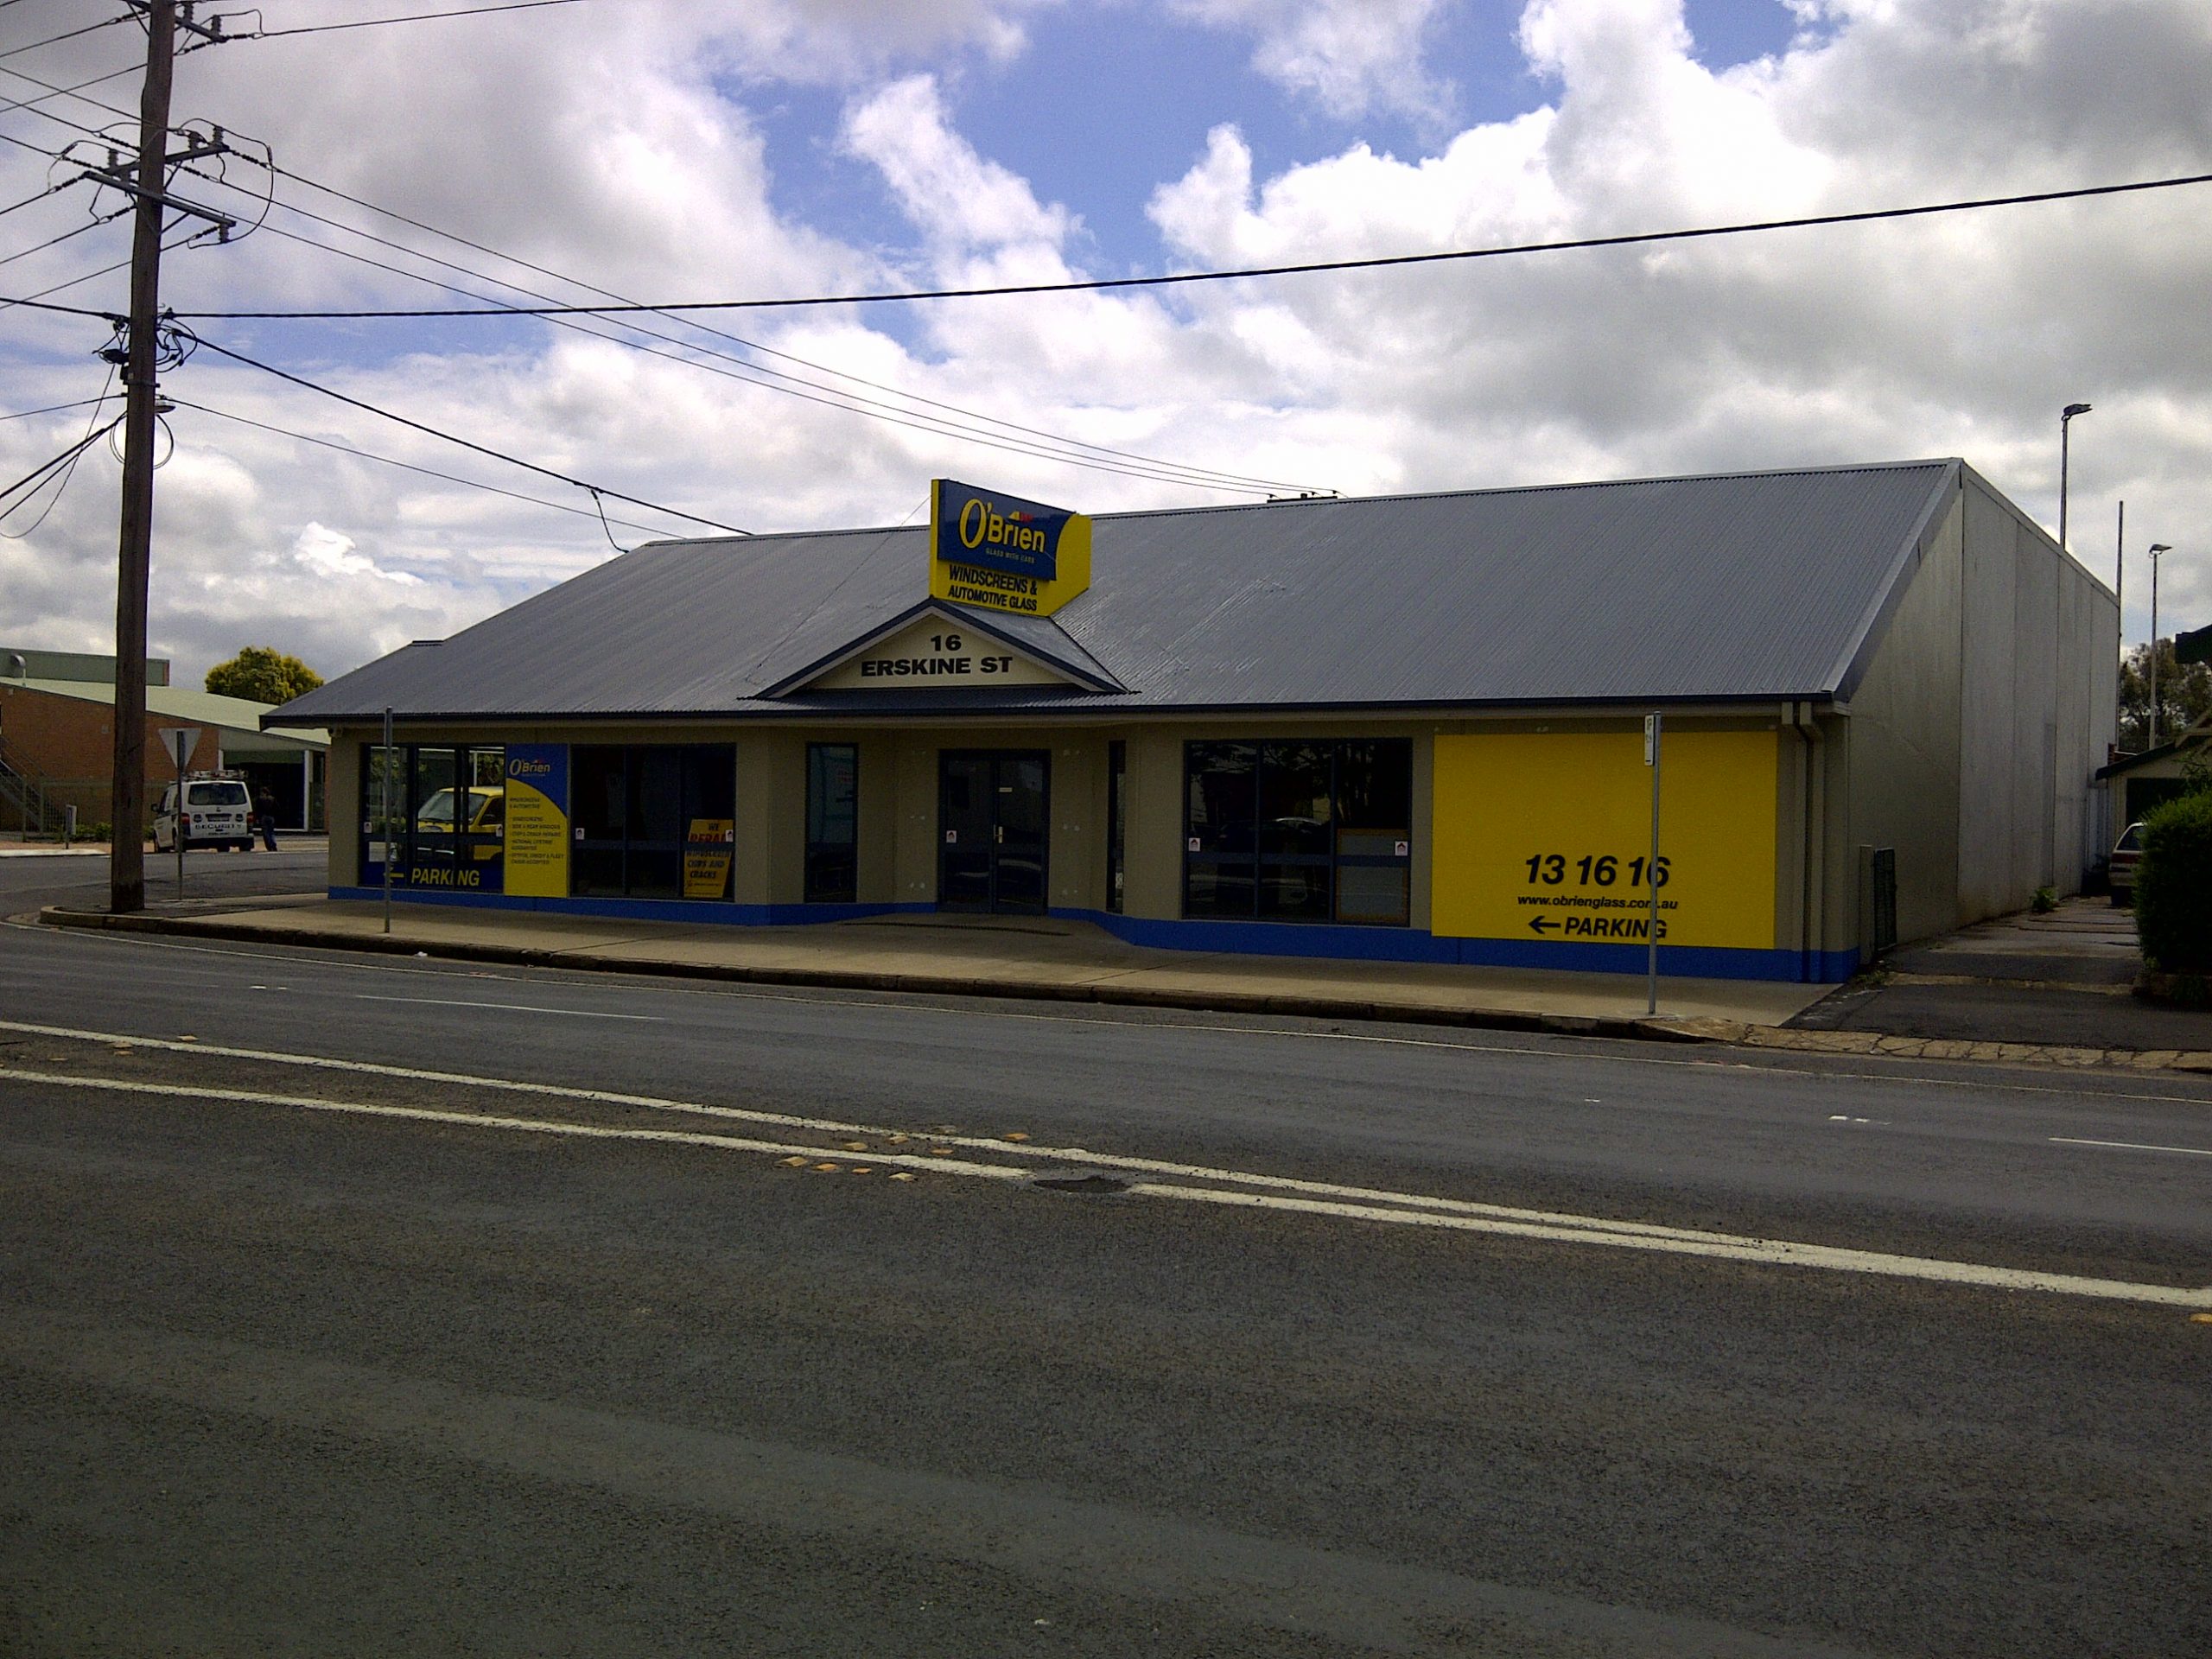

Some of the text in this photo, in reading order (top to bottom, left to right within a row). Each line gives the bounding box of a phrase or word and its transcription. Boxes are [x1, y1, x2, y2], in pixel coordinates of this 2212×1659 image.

[959, 499, 1045, 553] O'Brien
[950, 564, 1038, 594] WINDSCREENS &
[948, 585, 1037, 611] AUTOMOTIVE GLASS
[930, 634, 962, 652] 16
[861, 657, 1013, 677] ERSKINE ST
[509, 759, 550, 776] O'Brien
[410, 867, 480, 887] PARKING
[1525, 854, 1672, 887] 13 16 16
[1564, 917, 1667, 938] PARKING
